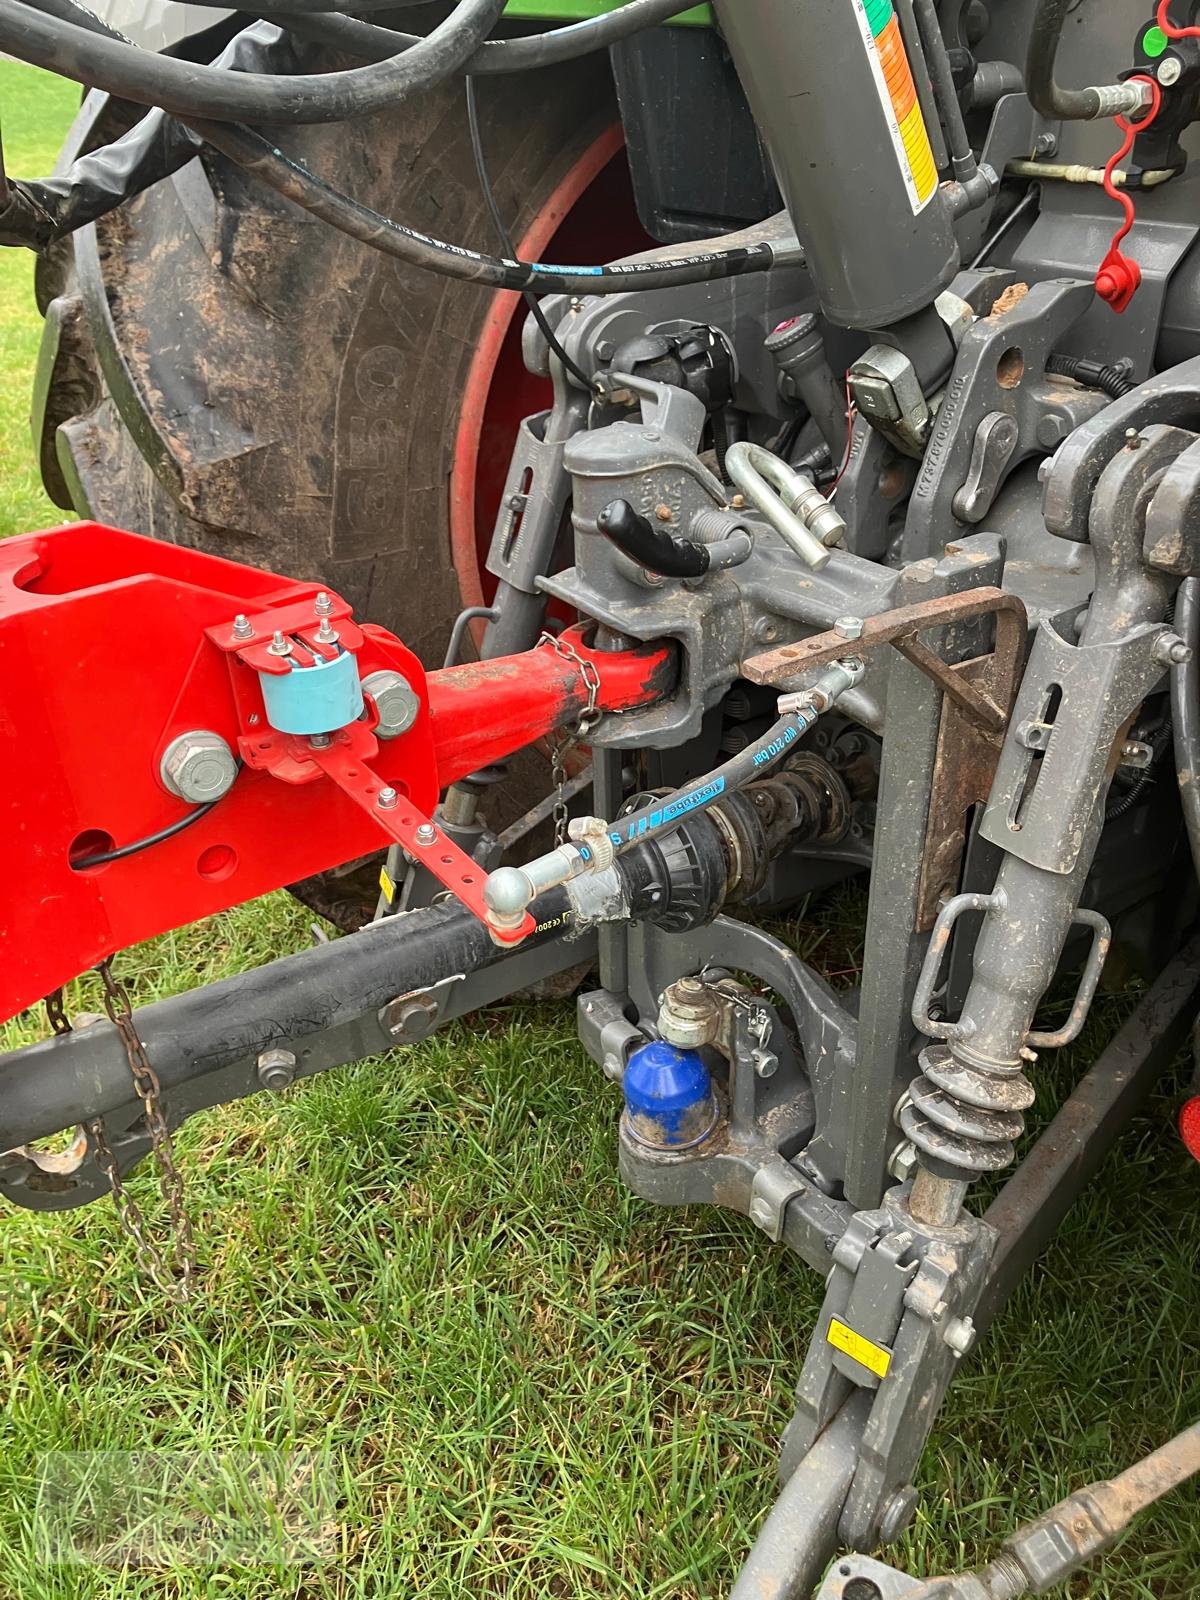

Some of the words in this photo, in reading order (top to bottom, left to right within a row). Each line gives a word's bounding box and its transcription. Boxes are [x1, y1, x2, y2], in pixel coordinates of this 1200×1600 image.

[783, 726, 797, 743] WP
[767, 737, 785, 756] 210
[753, 749, 770, 766] bar
[667, 783, 721, 815] flexitube
